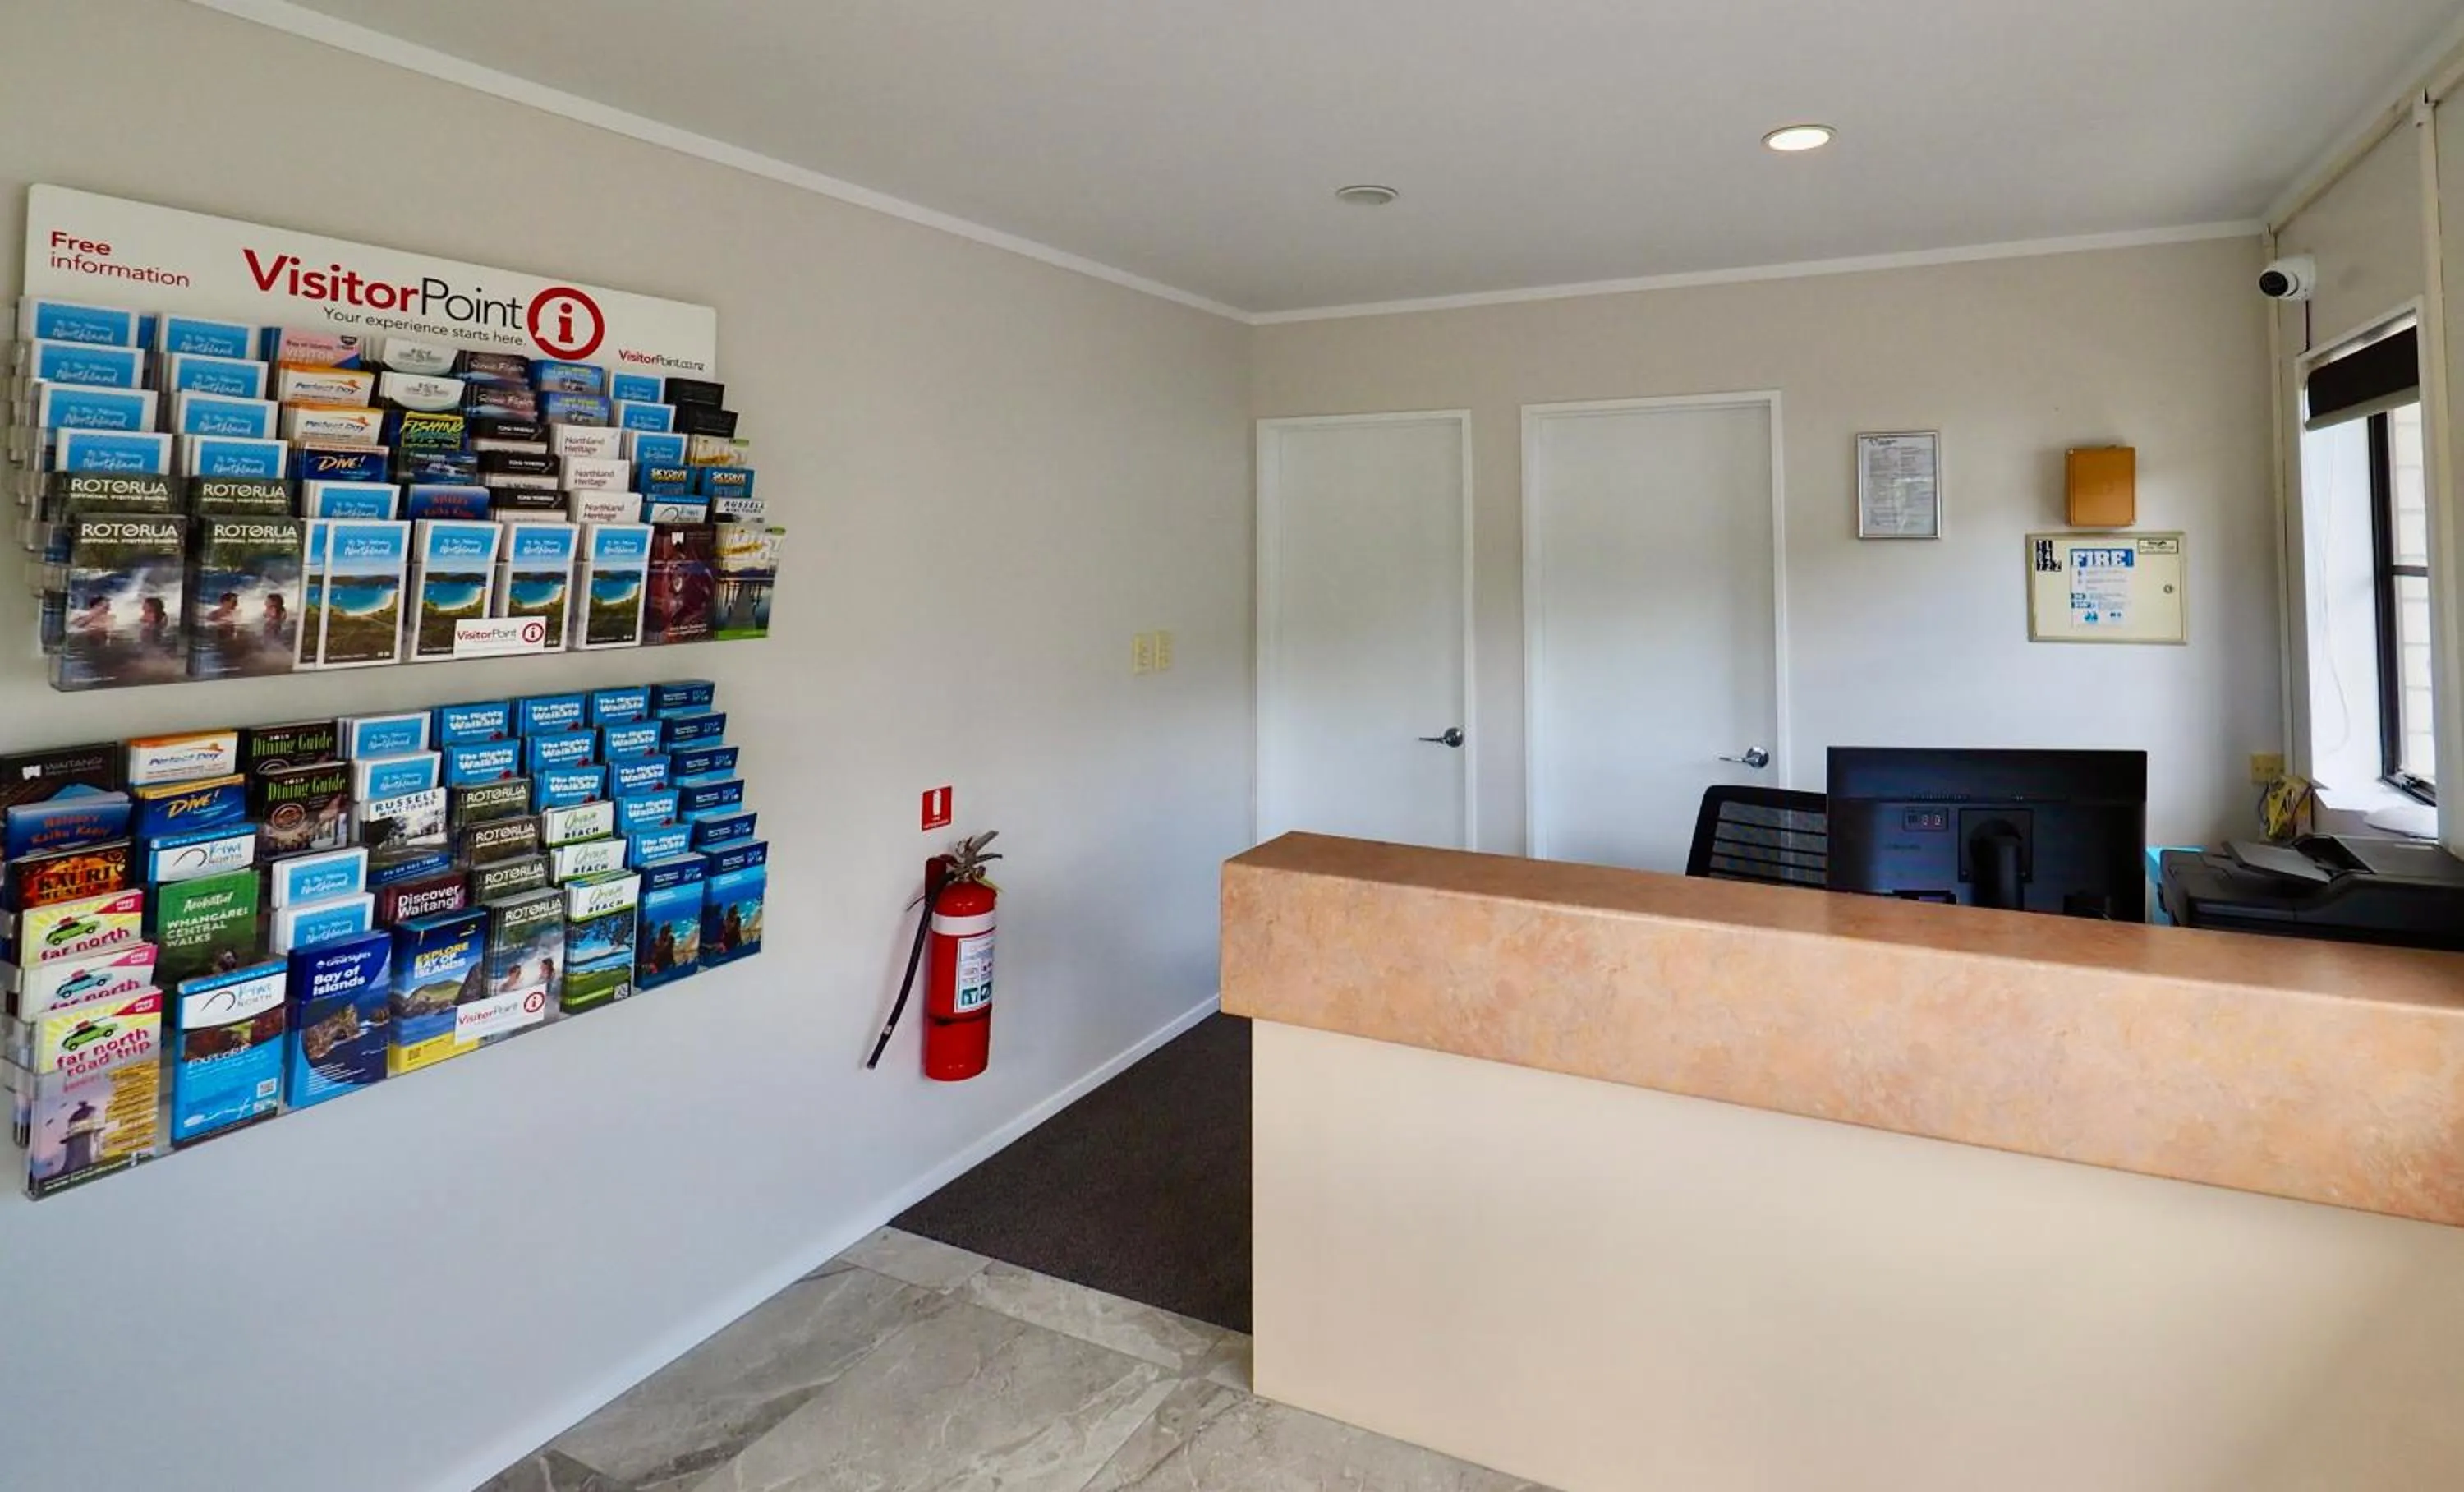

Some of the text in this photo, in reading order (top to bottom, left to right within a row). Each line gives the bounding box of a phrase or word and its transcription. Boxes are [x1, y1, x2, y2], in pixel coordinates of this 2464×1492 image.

[51, 231, 112, 256] Free
[51, 251, 190, 288] information
[243, 249, 523, 329] VisitorPoint
[323, 306, 526, 346] Your experience starts here.
[564, 444, 598, 456] Heritage
[565, 436, 605, 446] Northland
[574, 477, 608, 487] Heritage
[575, 469, 615, 478] Northland
[71, 478, 168, 495] ROTORUA
[203, 483, 285, 498] ROTORUA
[584, 503, 625, 513] Northland
[724, 500, 764, 509] RUSSELL
[583, 511, 617, 522] Heritage
[81, 523, 178, 538] ROTORUA
[214, 524, 297, 539] ROTORUA
[2072, 550, 2126, 568] FIRE
[457, 627, 517, 641] VisitorPoint
[449, 718, 503, 730] Waikato
[450, 714, 469, 723] The
[252, 730, 333, 757] Dining Guide
[459, 753, 477, 762] The
[459, 757, 513, 770] Waikato
[268, 772, 346, 801] Dining Guide
[466, 785, 526, 803] ROTORUA
[375, 791, 438, 813] RUSSELL
[476, 822, 534, 843] ROTORUA
[565, 827, 599, 839] BEACH
[485, 863, 544, 885] ROTORUA
[573, 863, 609, 873] BEACH
[398, 885, 460, 908] Discover
[398, 896, 459, 918] Waitangi
[505, 898, 562, 921] ROTORUA
[588, 900, 623, 913] BEACH
[168, 921, 227, 939] CENTRAL
[40, 927, 131, 961] far north
[168, 932, 212, 948] WALKS
[416, 942, 470, 963] EXPLORE
[315, 965, 361, 986] Bay of
[313, 977, 365, 997] Islands
[56, 1028, 149, 1069] far north
[67, 1040, 152, 1077] road trip
